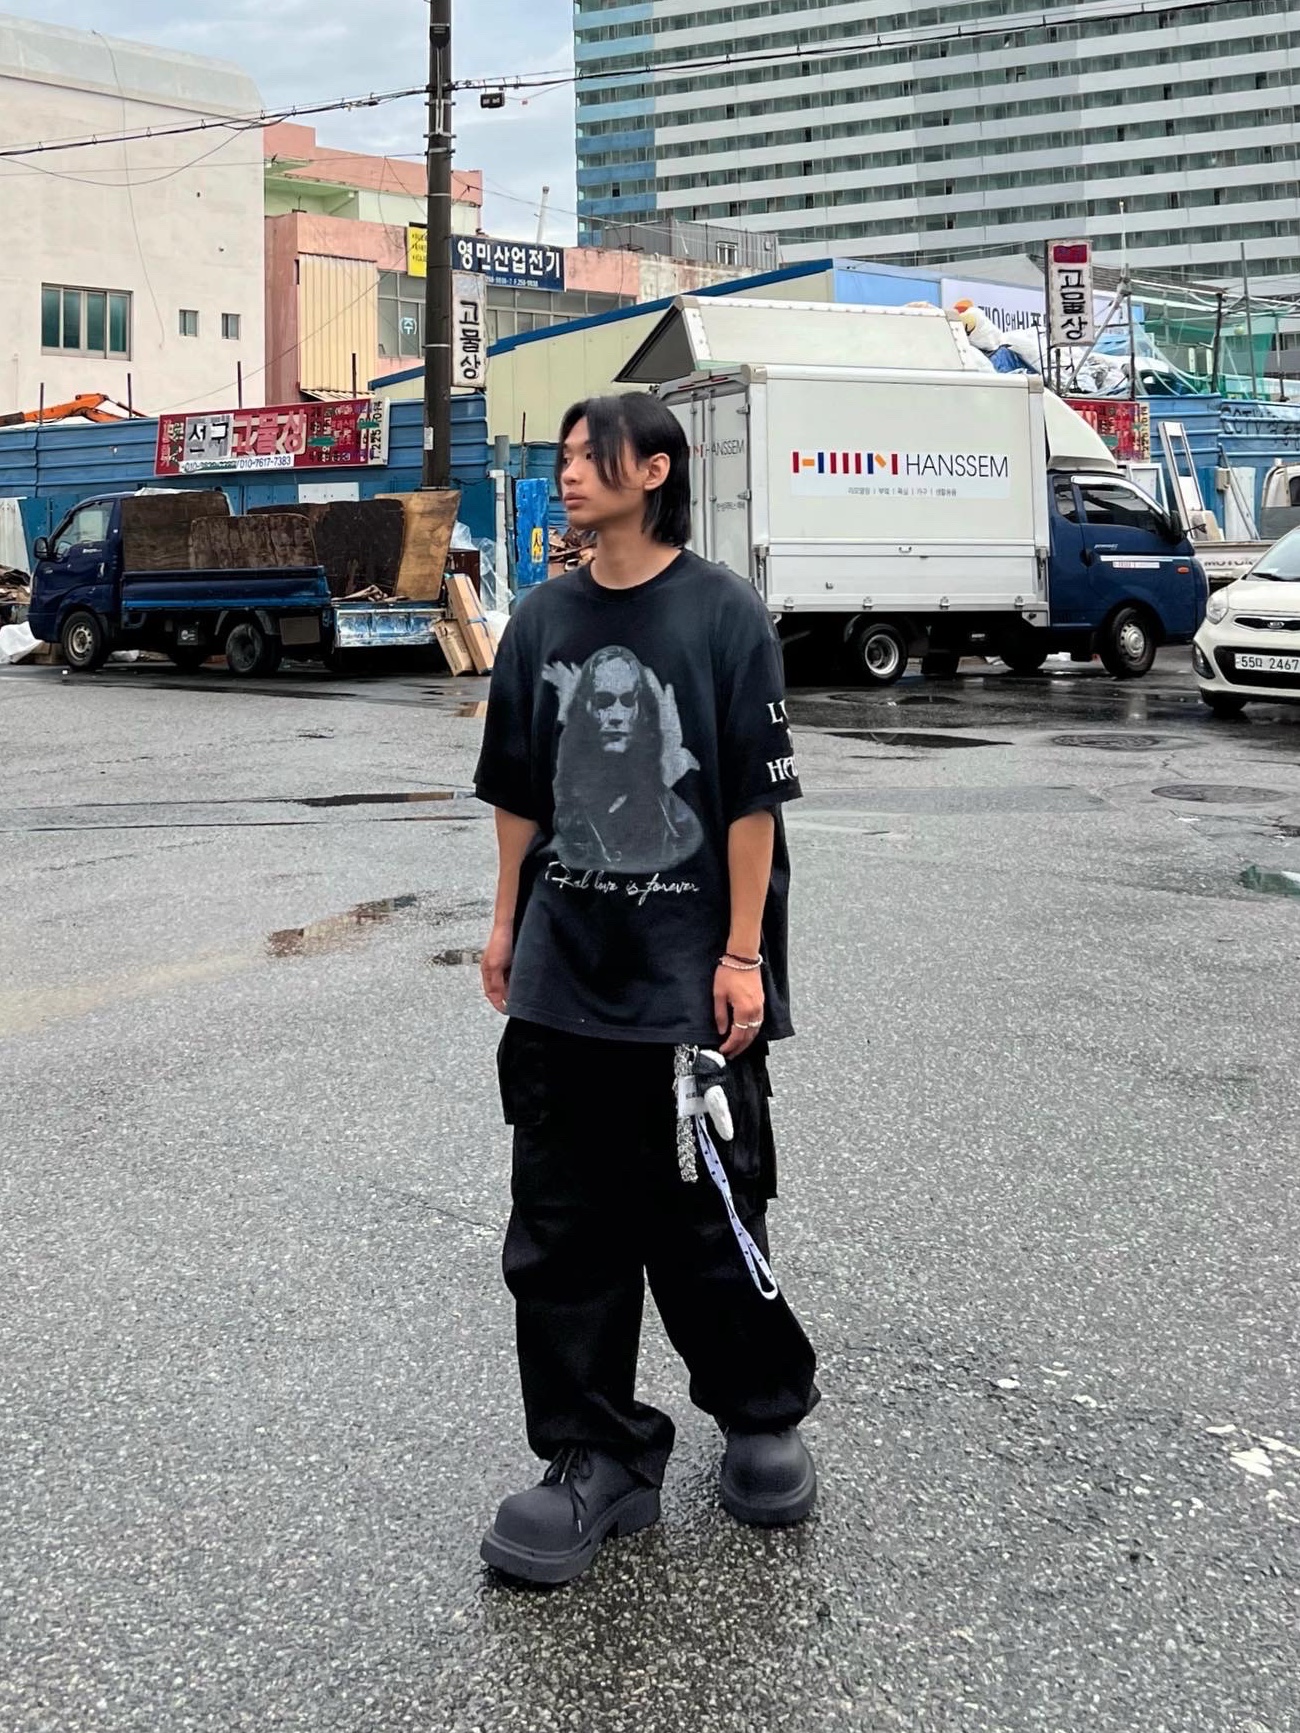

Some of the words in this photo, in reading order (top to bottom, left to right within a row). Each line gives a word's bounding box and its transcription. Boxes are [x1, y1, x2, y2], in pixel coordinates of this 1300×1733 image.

[458, 240, 560, 278] 영민산업전기
[1058, 269, 1088, 340] 고물상
[459, 300, 481, 379] 고물상
[188, 421, 229, 454] 선구
[906, 454, 1009, 478] HANSSEM
[1269, 657, 1299, 671] 2467
[639, 872, 700, 906] forever
